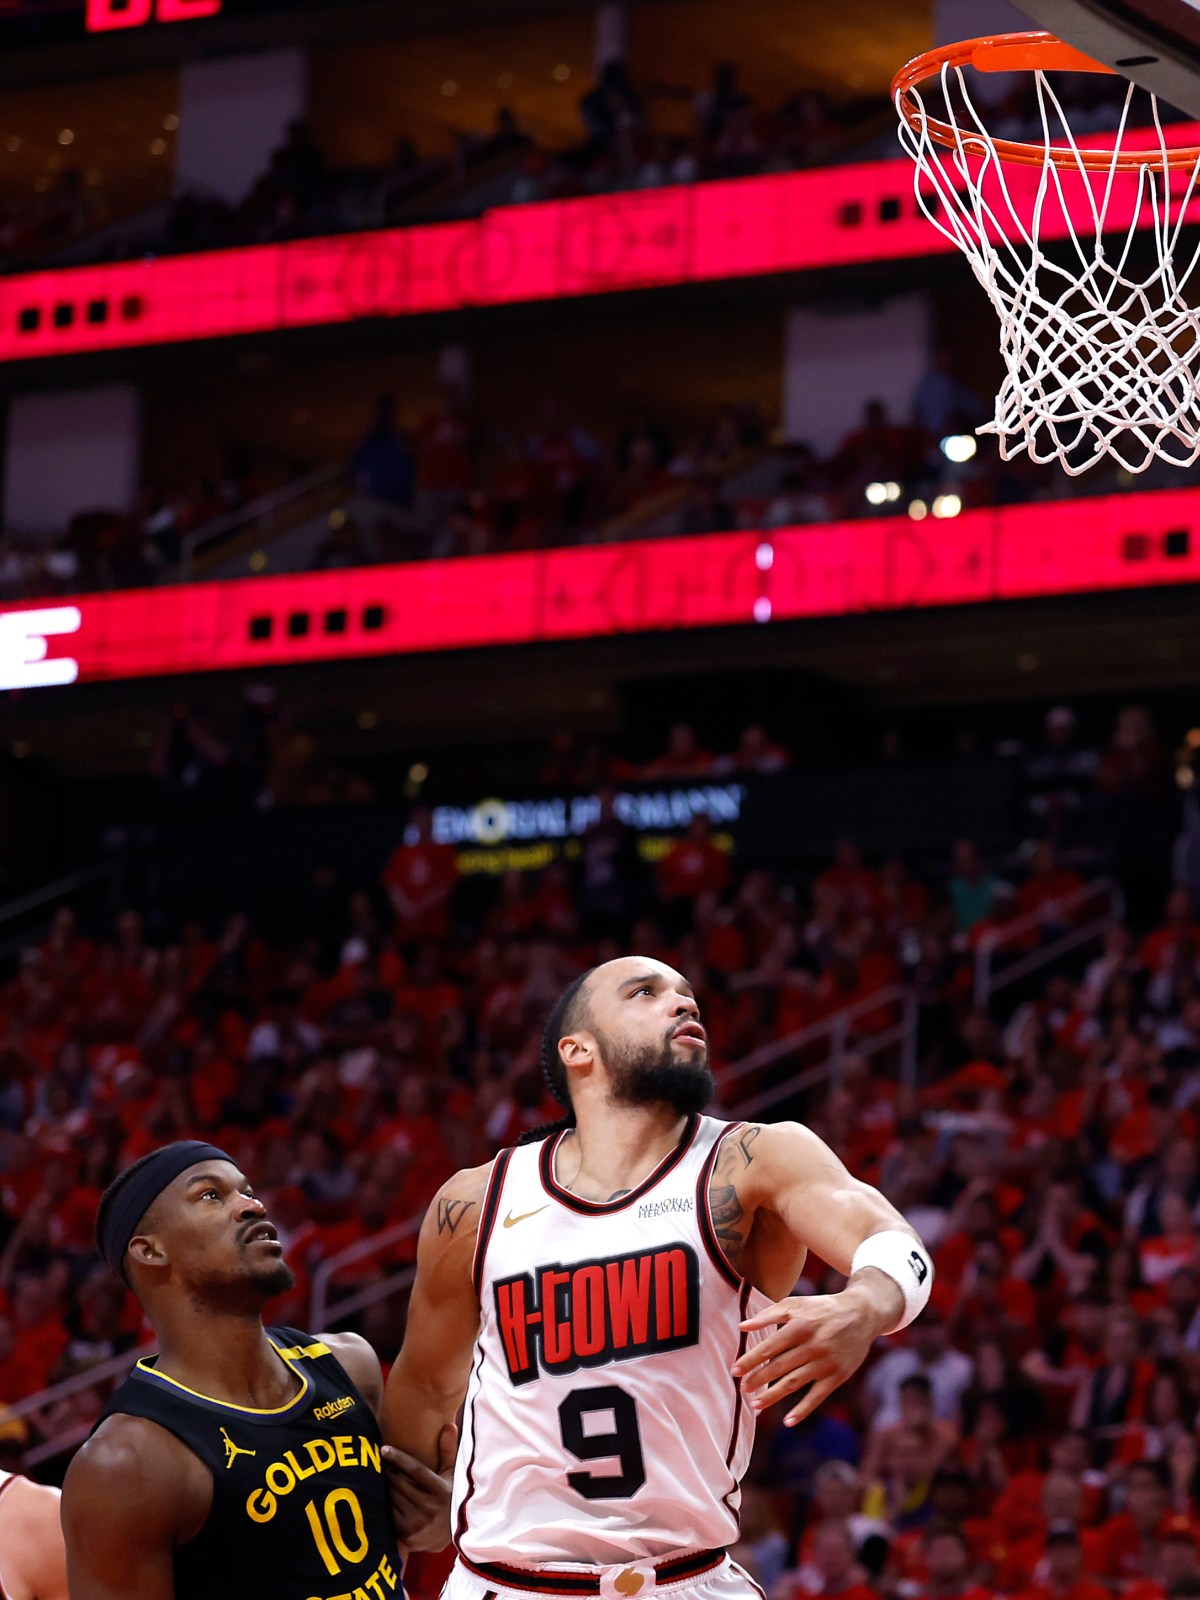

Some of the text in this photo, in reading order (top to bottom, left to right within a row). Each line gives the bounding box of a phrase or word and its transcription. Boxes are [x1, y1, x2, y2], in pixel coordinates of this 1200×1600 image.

[313, 1396, 355, 1421] Rakuten
[558, 1385, 646, 1499] 9
[246, 1435, 381, 1523] GOLDEN
[304, 1487, 369, 1576] 10
